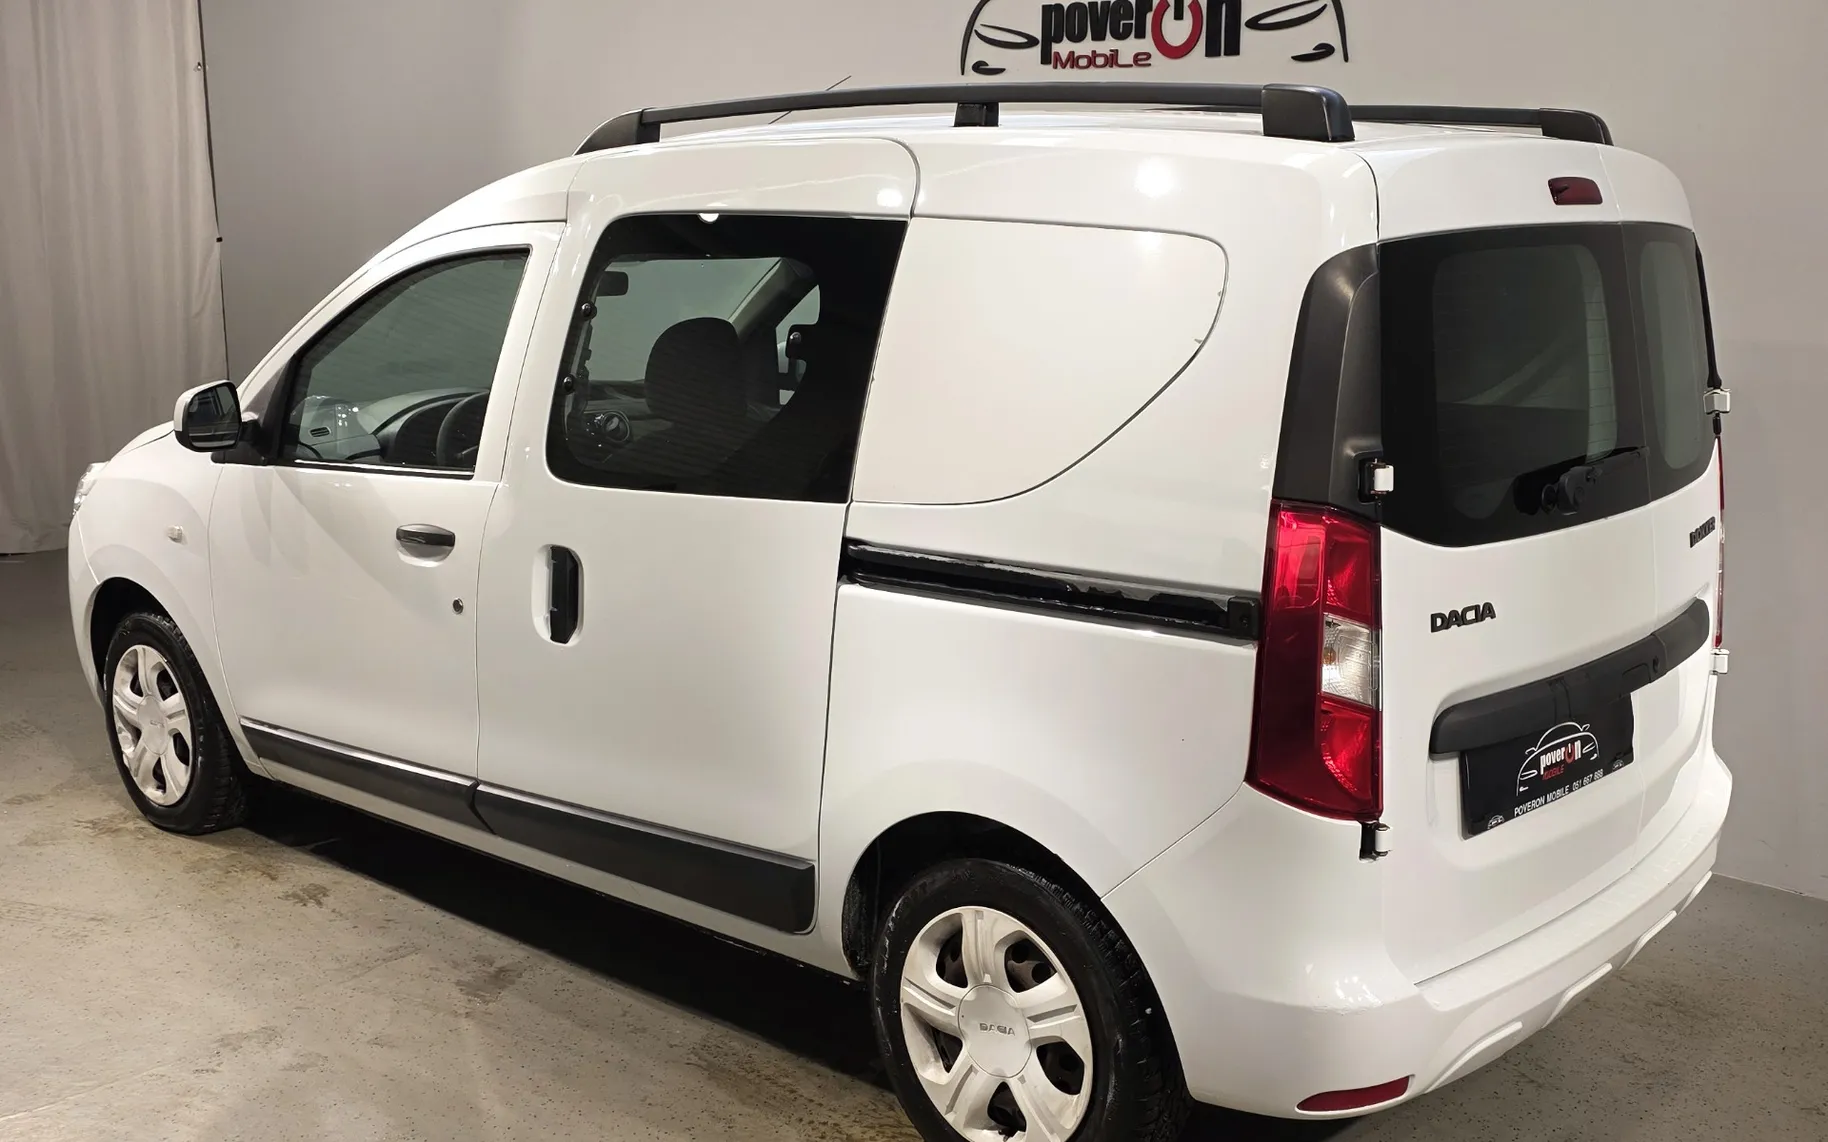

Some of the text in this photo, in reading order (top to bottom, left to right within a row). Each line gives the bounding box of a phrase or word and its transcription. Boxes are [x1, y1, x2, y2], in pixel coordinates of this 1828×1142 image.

[1430, 602, 1496, 633] DACIA
[1514, 795, 1545, 817] POVERON
[1547, 785, 1570, 803] MOBILE
